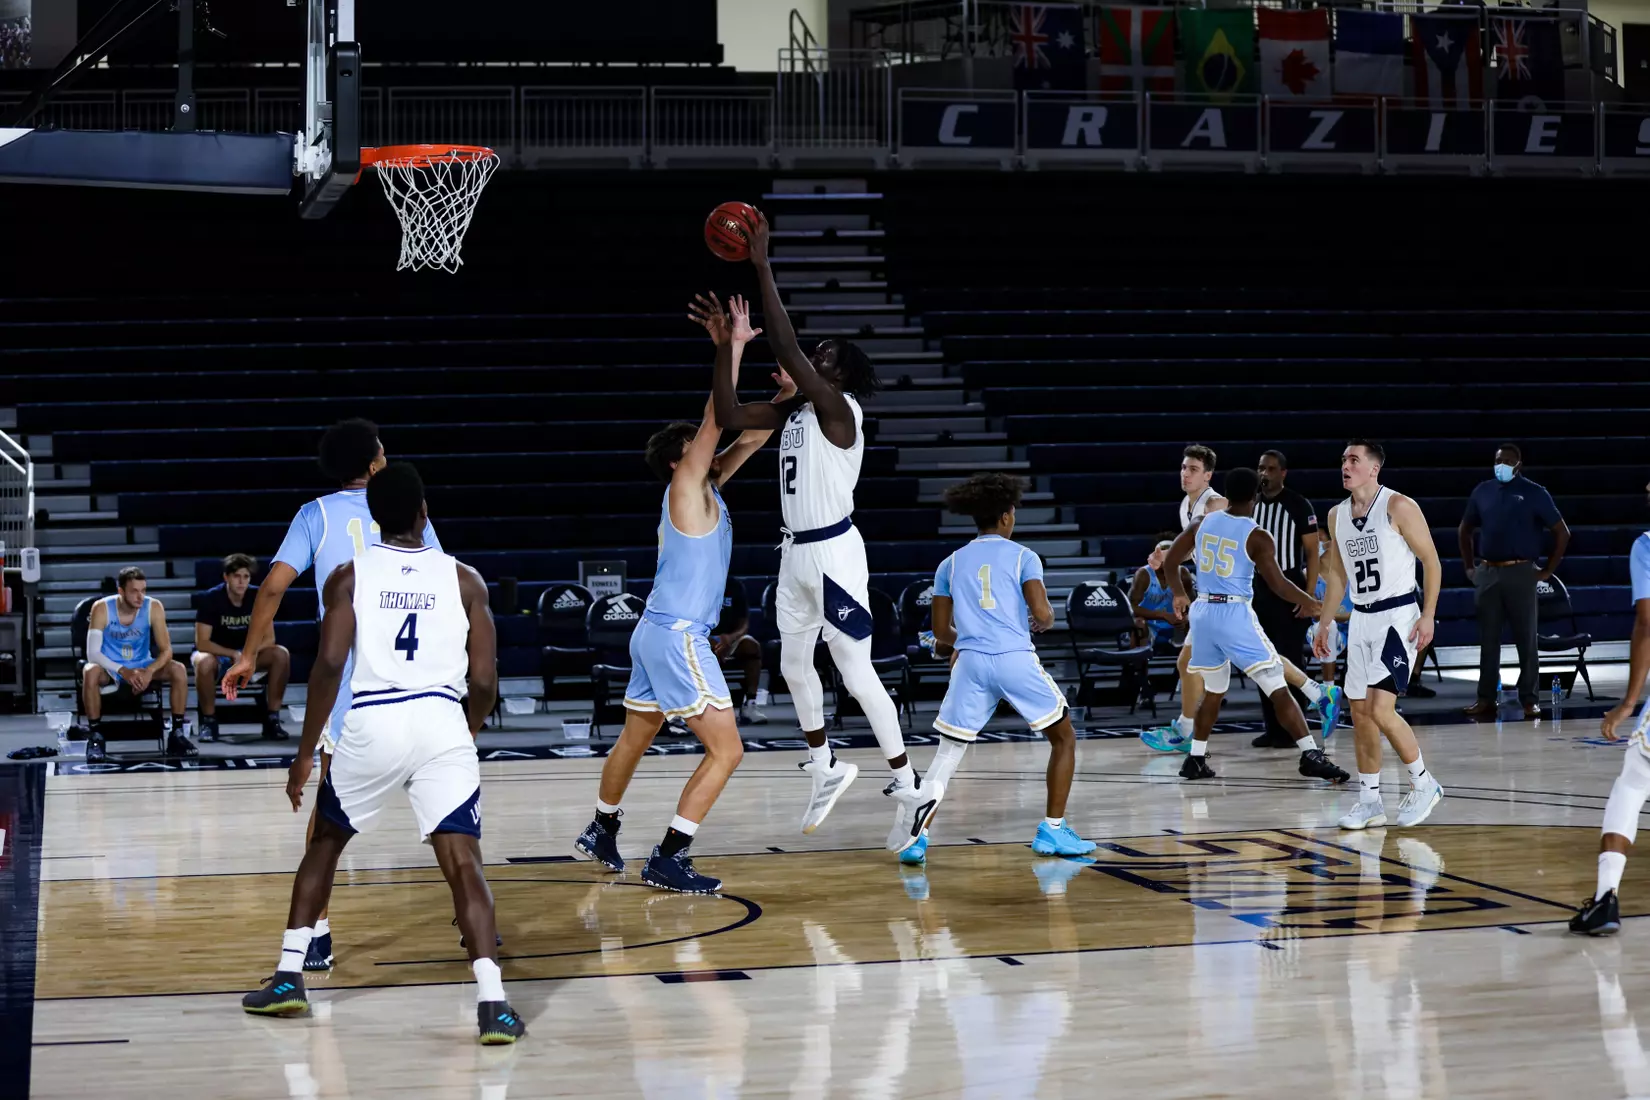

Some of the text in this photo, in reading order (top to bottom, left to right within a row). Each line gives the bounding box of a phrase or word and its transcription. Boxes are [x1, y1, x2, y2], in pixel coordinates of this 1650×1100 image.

[782, 427, 804, 450] BU
[782, 456, 797, 495] 12
[347, 518, 382, 556] 1
[1345, 535, 1379, 557] CBU
[1200, 533, 1238, 578] 55
[977, 564, 997, 610] 1
[1354, 558, 1381, 594] 25
[380, 591, 435, 610] THOMAS
[553, 599, 586, 609] adidas
[1084, 597, 1118, 607] adidas
[603, 611, 640, 621] adidas
[395, 613, 419, 661] 4
